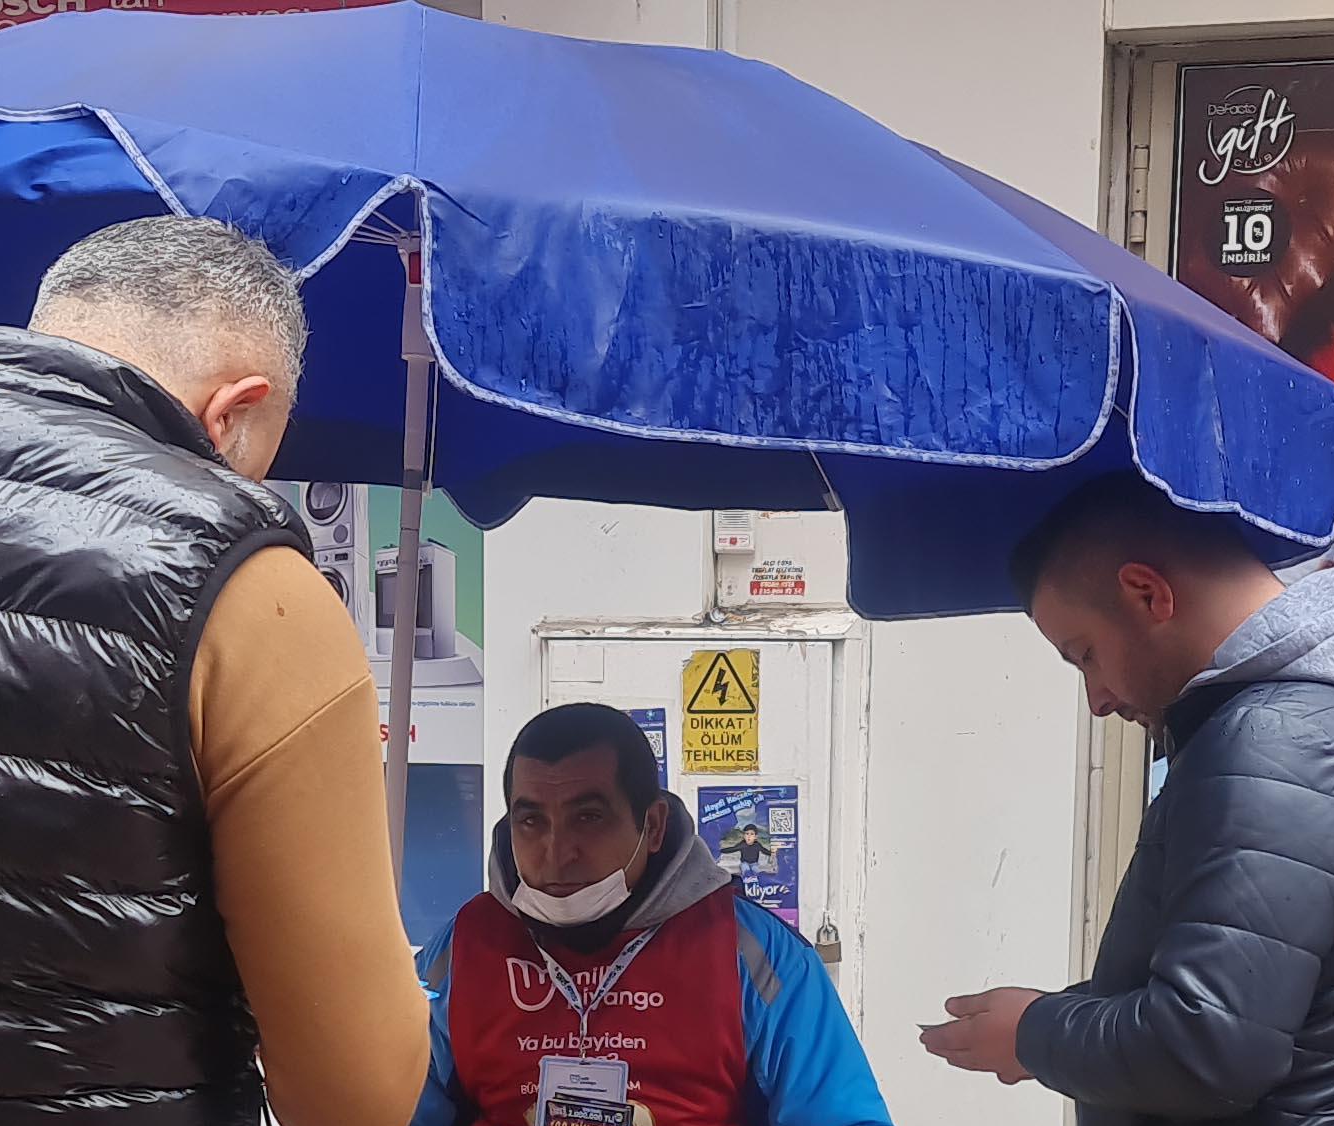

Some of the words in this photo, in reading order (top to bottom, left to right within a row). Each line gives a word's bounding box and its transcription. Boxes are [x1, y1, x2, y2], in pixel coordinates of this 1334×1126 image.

[1199, 89, 1295, 184] gift
[1233, 154, 1273, 168] CLUB
[1222, 213, 1272, 251] 10
[1222, 252, 1271, 263] İNDİRİM
[690, 716, 744, 729] DİKKAT
[701, 731, 742, 746] ÖLÜM
[685, 748, 759, 762] TEHLİKESİ
[745, 882, 778, 900] kliyor
[518, 1036, 539, 1051] Ya
[542, 1035, 565, 1050] bu
[569, 1032, 647, 1051] bayiden
